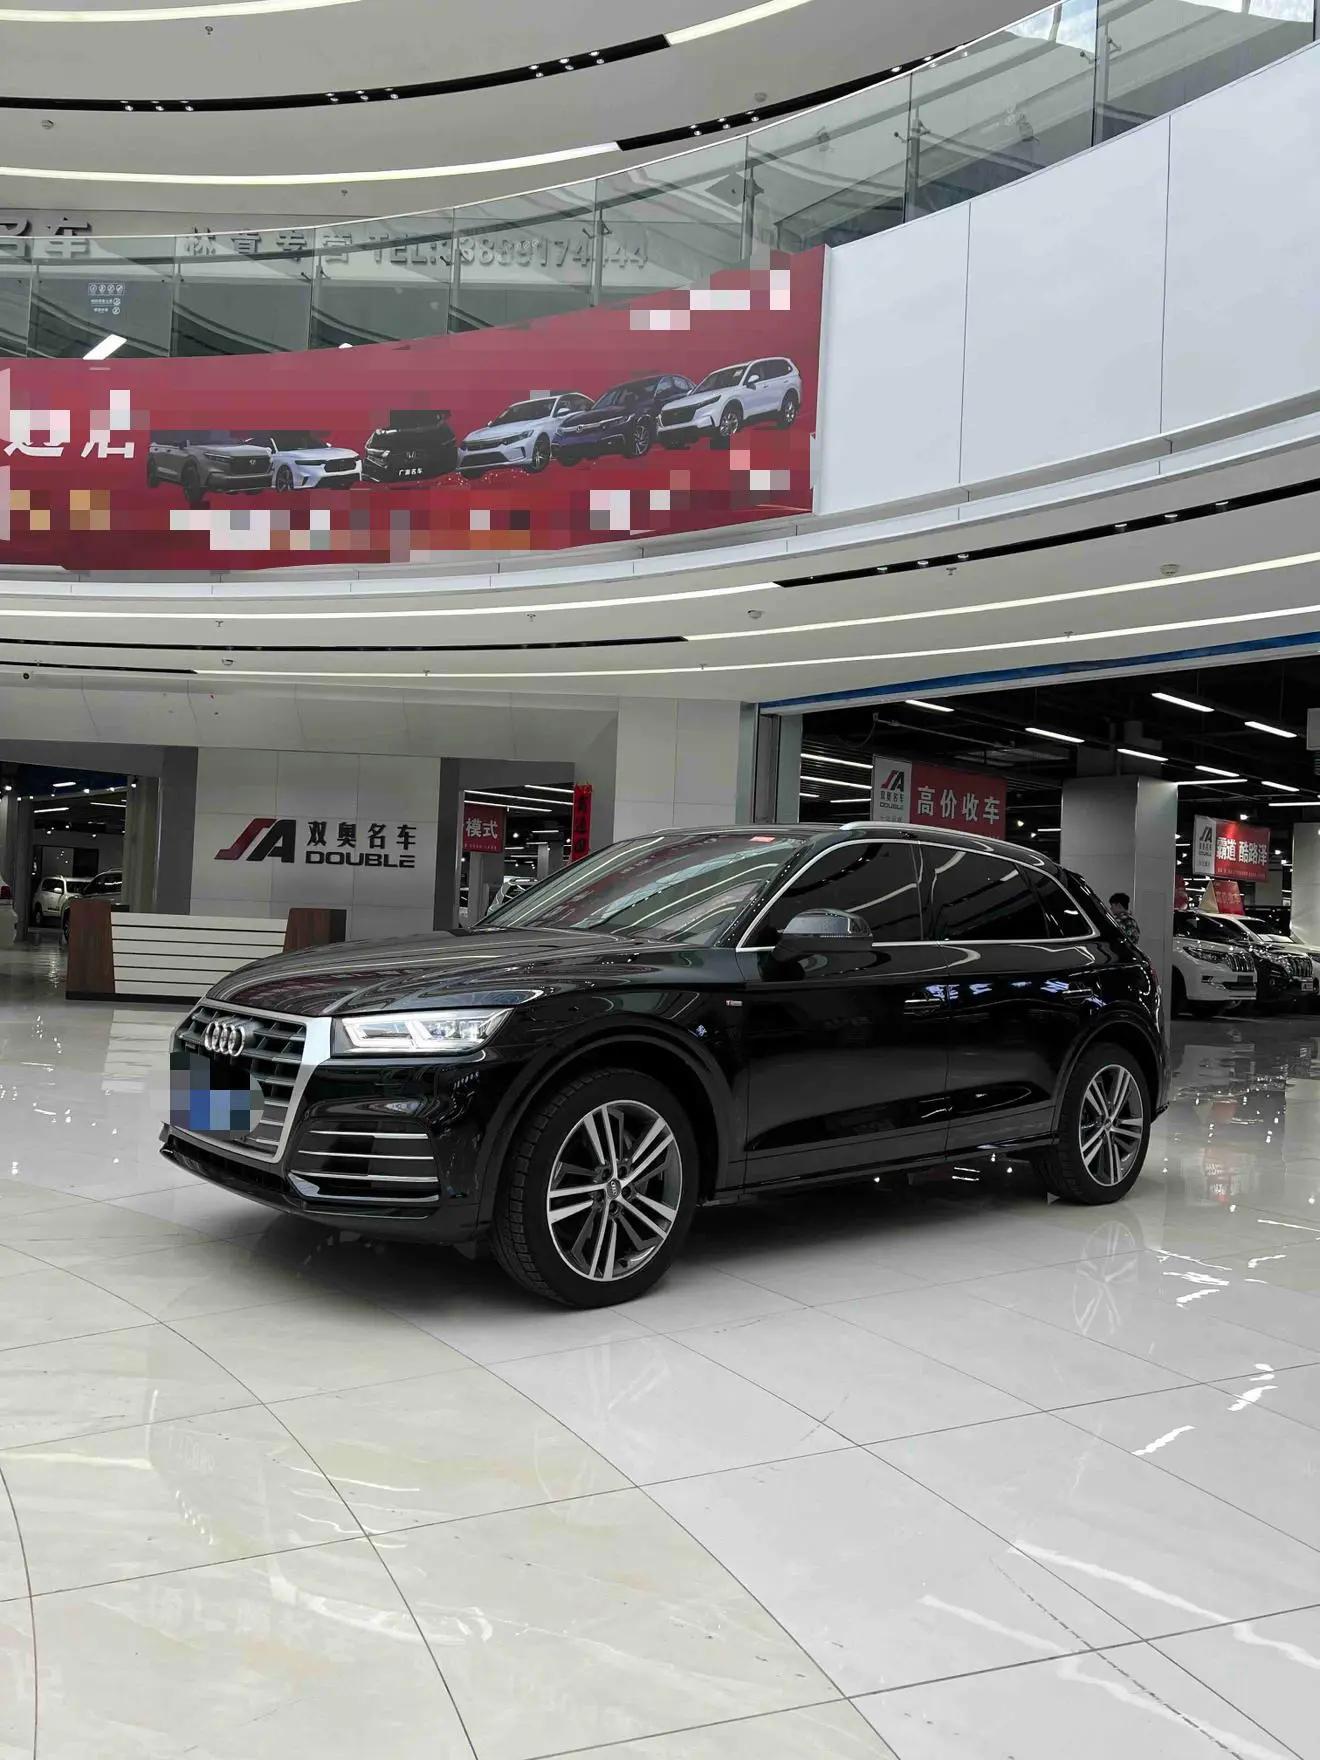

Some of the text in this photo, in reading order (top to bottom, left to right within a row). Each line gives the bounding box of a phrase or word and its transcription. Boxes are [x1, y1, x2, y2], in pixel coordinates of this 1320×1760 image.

[917, 785, 1000, 825] 高价收车
[306, 820, 417, 850] 双奥名车
[465, 817, 498, 839] 模式
[305, 850, 416, 868] DOUBLE
